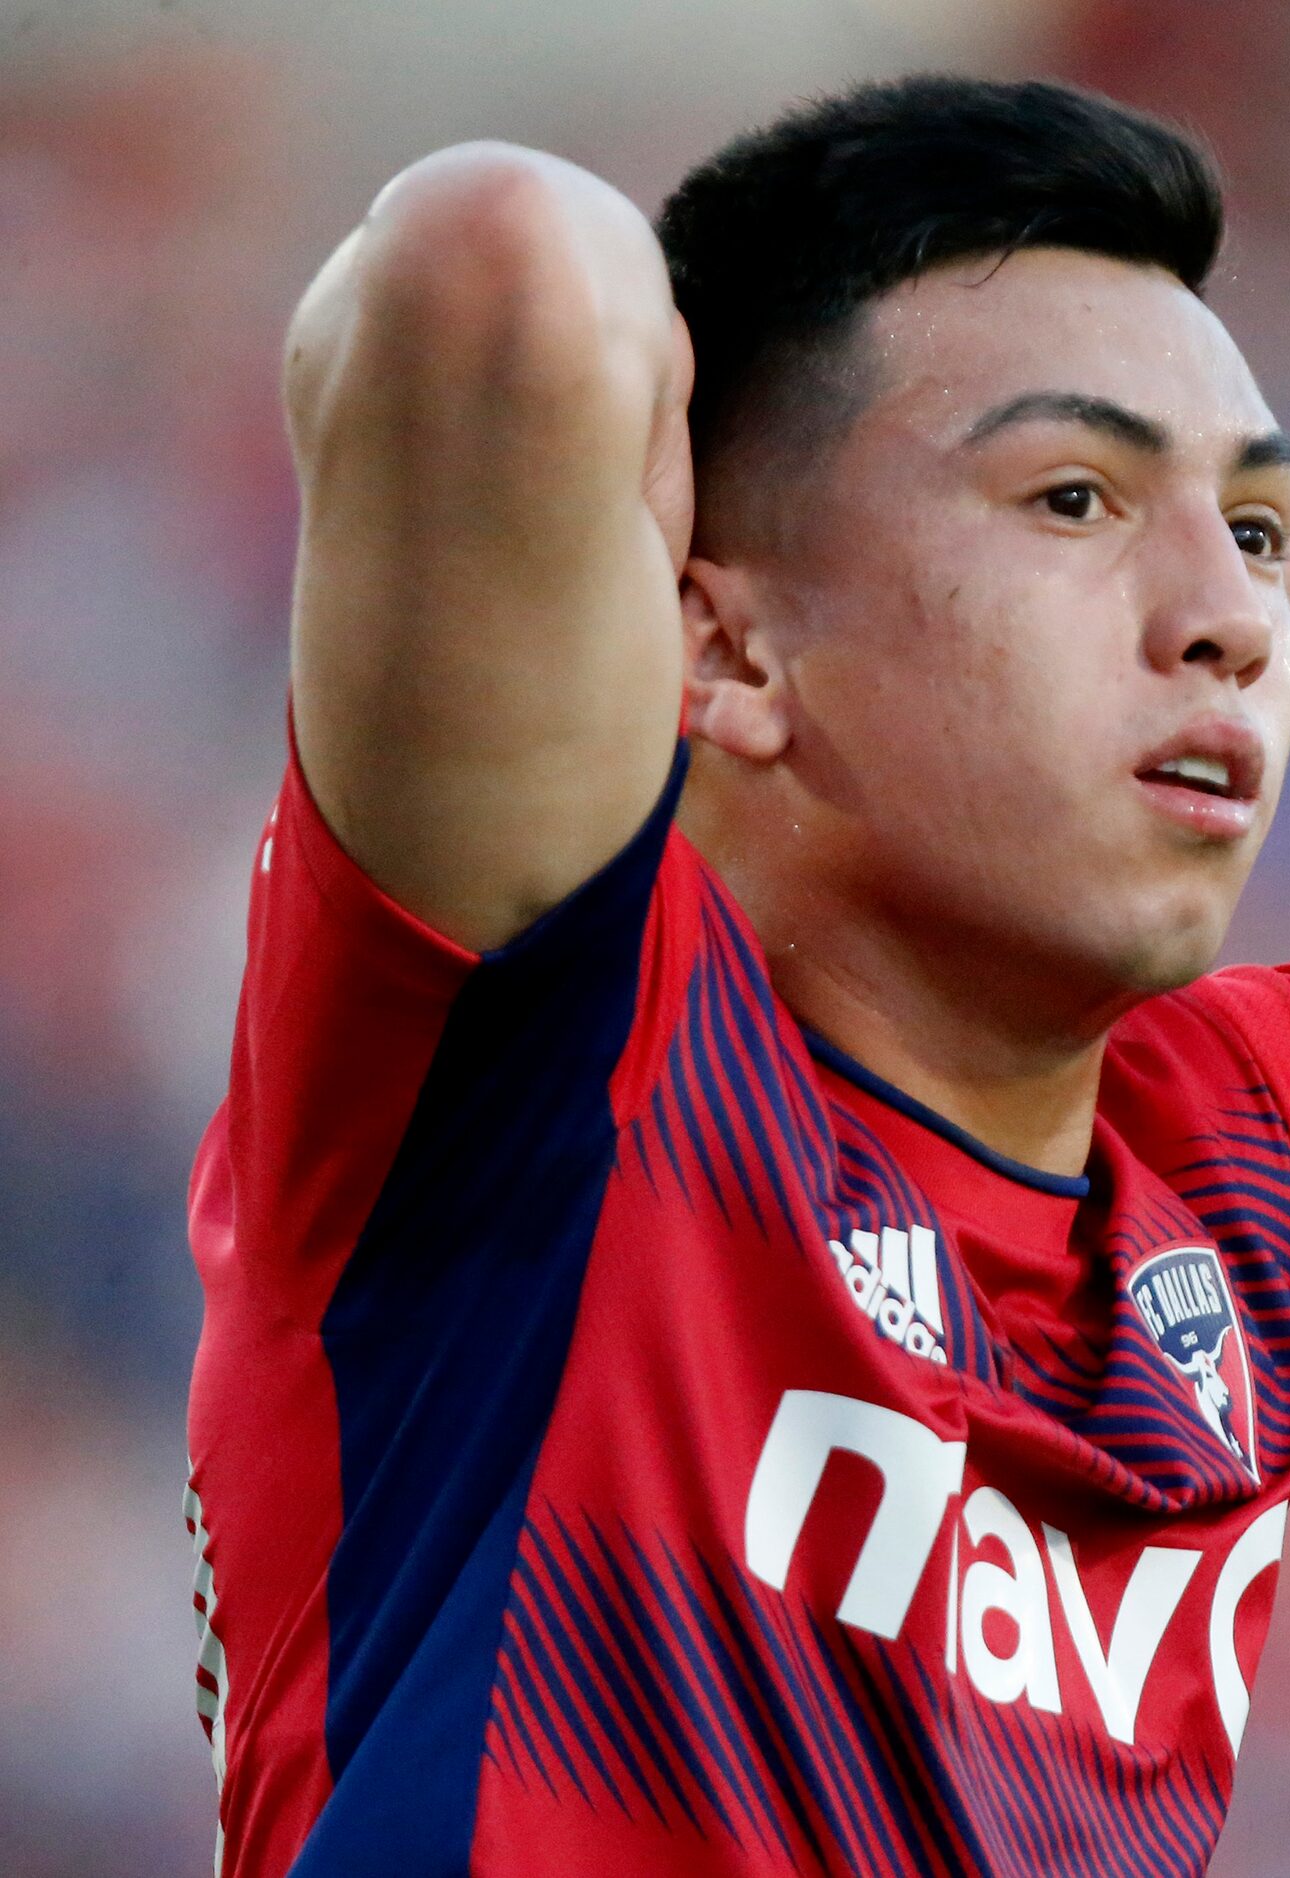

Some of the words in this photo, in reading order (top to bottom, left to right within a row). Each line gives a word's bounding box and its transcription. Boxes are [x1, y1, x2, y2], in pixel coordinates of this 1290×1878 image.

[1136, 1284, 1165, 1341] FC
[1152, 1263, 1222, 1328] DALLAS
[1180, 1330, 1199, 1349] 96
